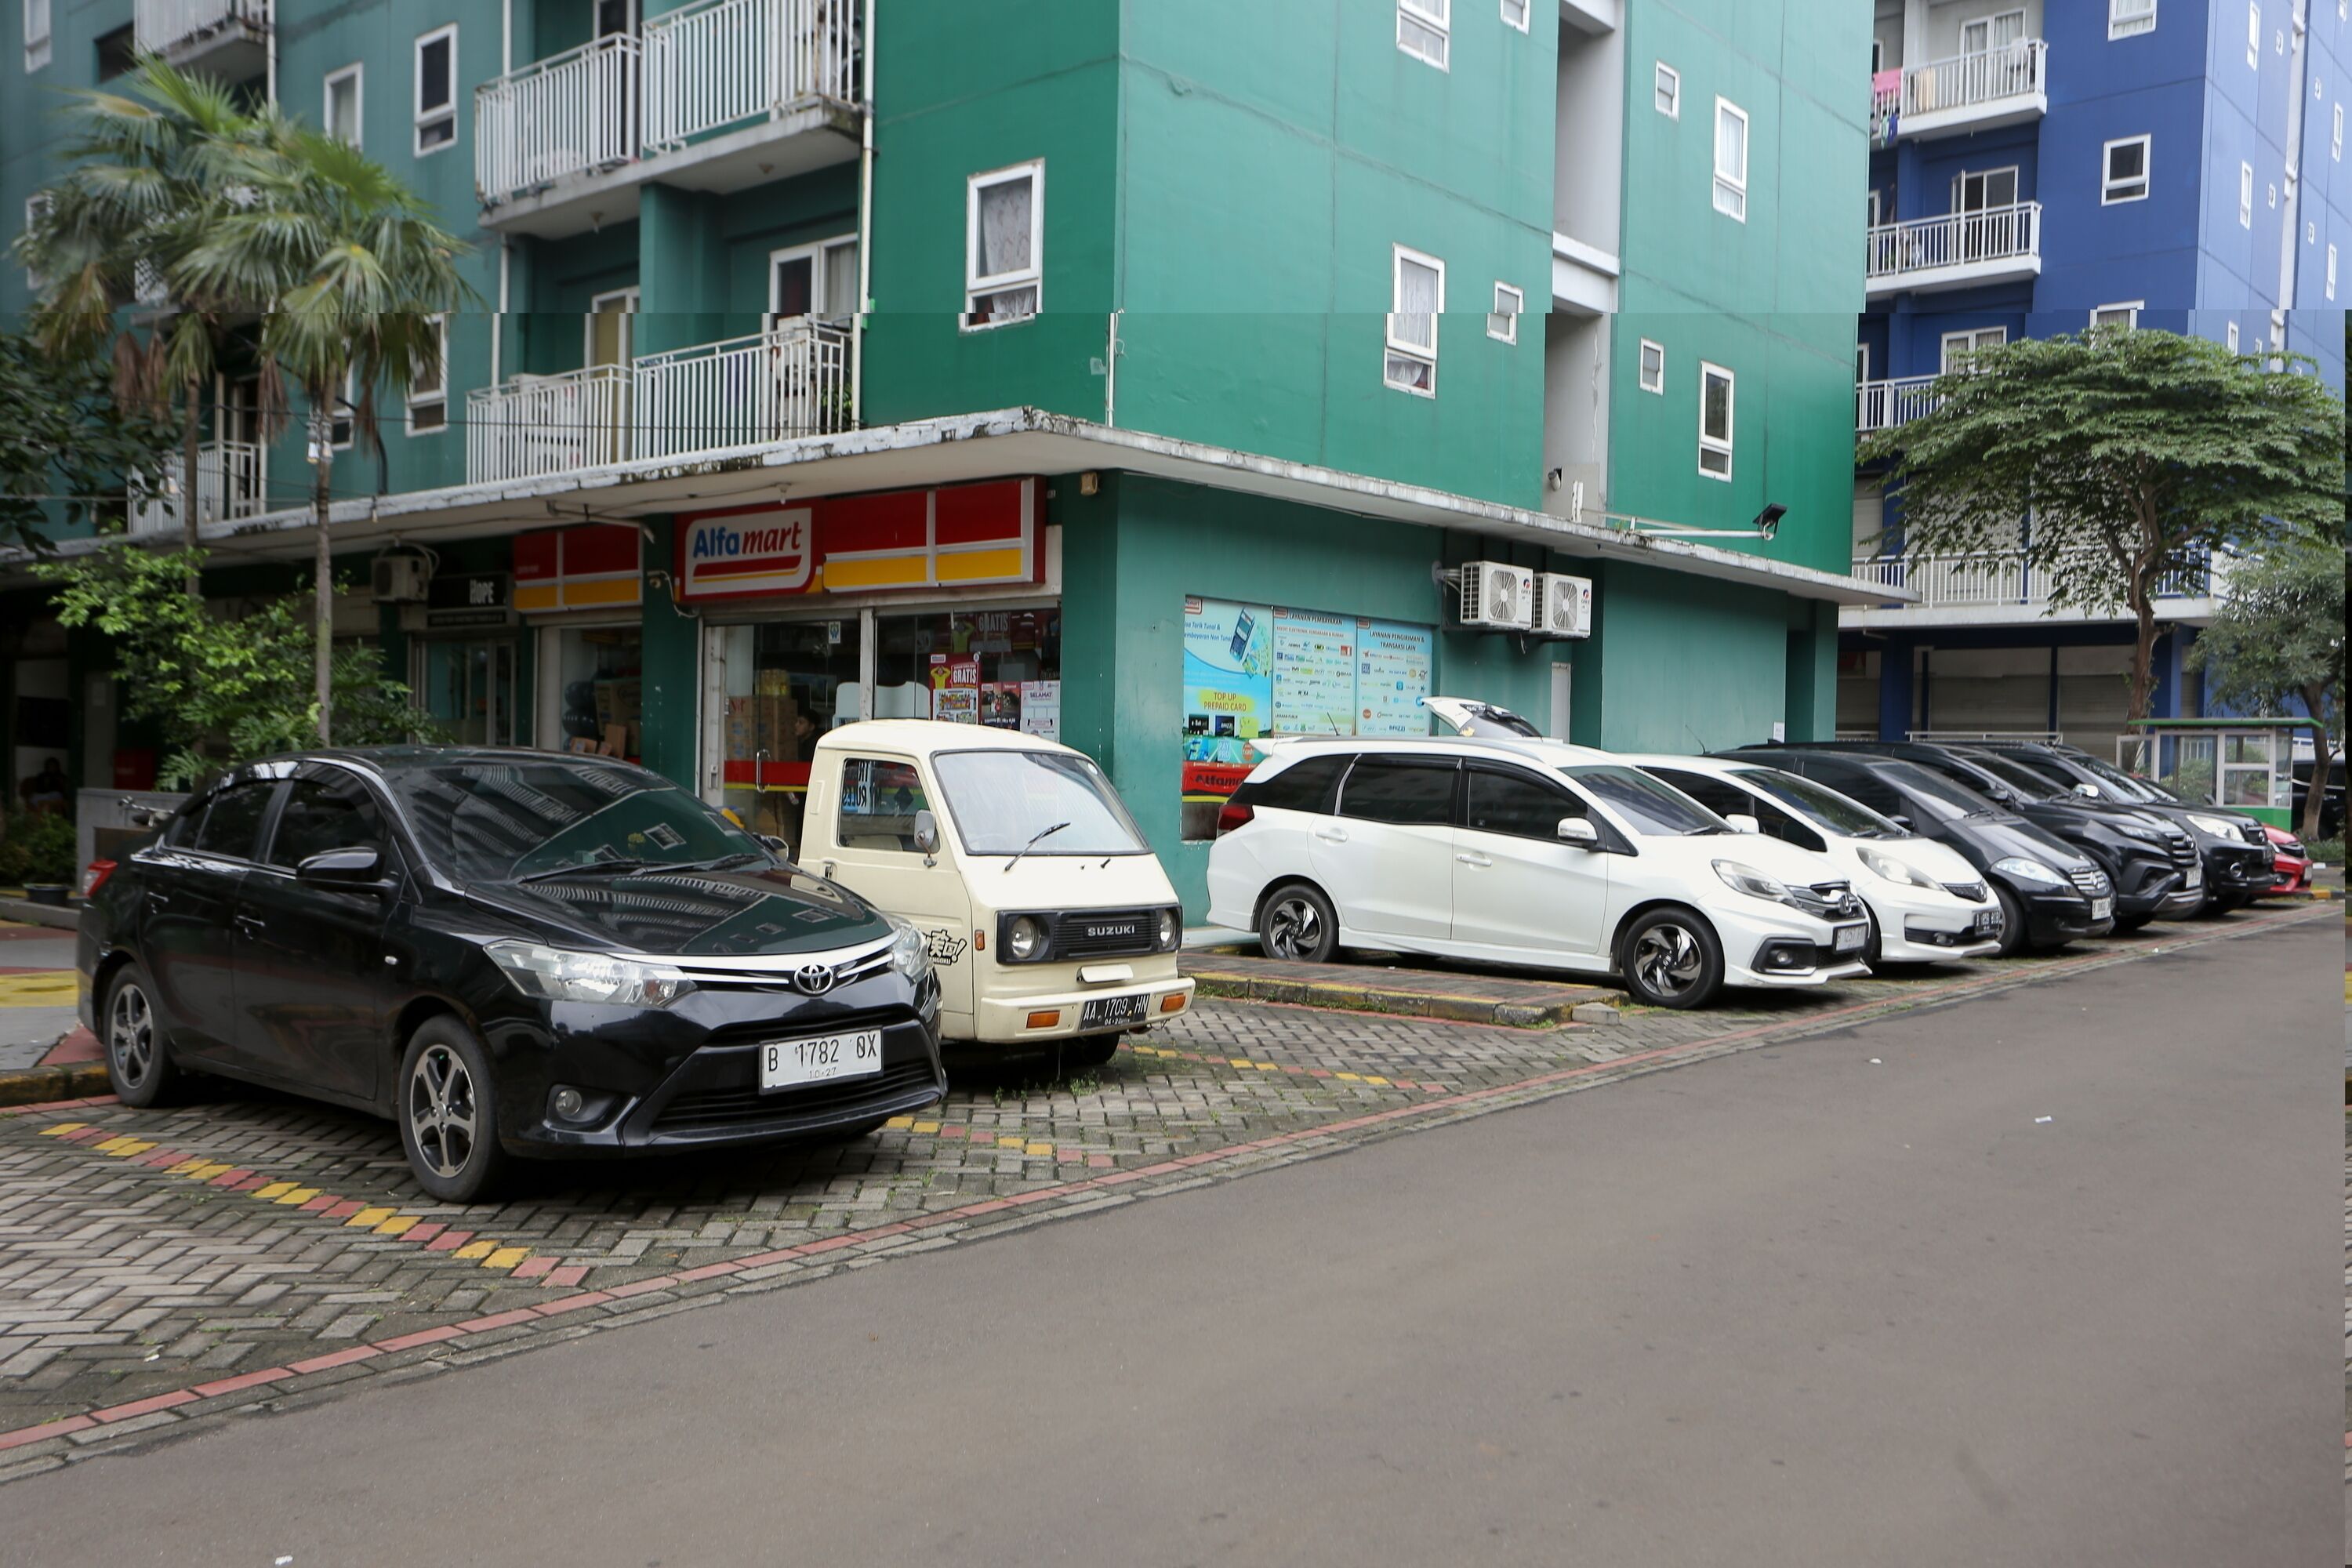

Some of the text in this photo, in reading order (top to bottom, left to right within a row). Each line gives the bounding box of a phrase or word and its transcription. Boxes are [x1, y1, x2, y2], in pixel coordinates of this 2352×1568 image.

[693, 521, 803, 558] Alfamart
[979, 612, 1009, 631] GRATIS
[1185, 631, 1210, 641] embayaran
[1370, 630, 1391, 639] LAYANAN
[1381, 641, 1406, 651] TRANSAKSI
[953, 668, 977, 684] GRATIS
[1214, 691, 1236, 702] TOP UP
[1203, 701, 1247, 712] PREPAID CARD
[1087, 924, 1135, 937] SUZUKI
[1083, 994, 1149, 1022] AA 1709 HN
[768, 1047, 779, 1073] B
[798, 1039, 840, 1067] 1782
